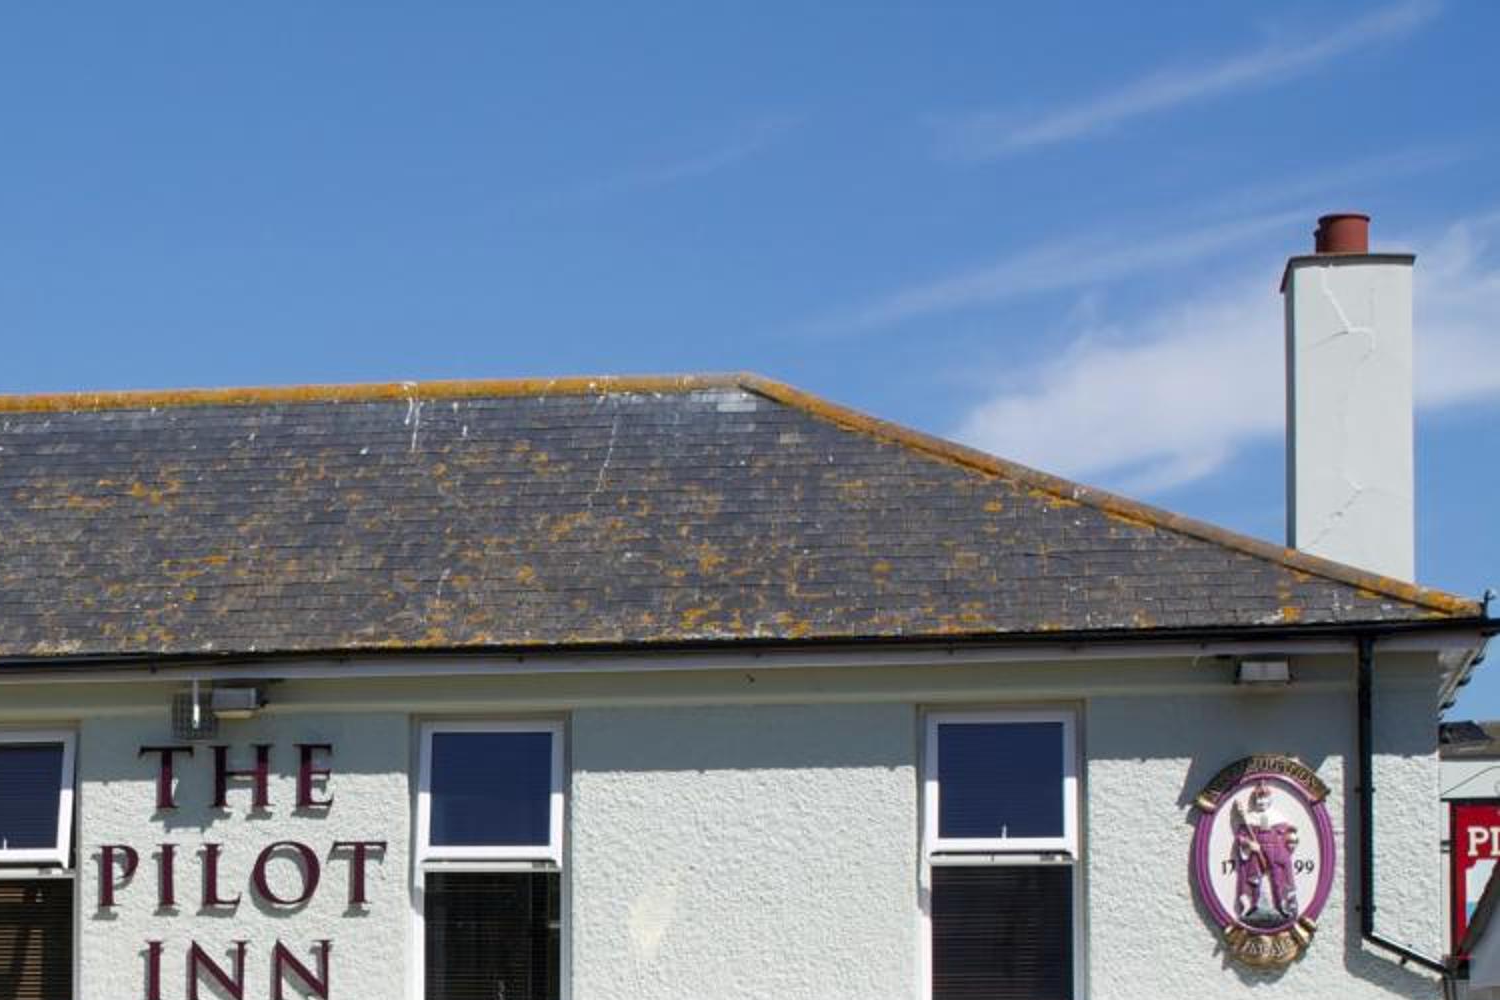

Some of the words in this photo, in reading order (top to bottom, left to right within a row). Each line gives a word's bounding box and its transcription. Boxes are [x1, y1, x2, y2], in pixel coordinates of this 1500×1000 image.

[138, 743, 334, 809] THE
[98, 841, 388, 907] PILOT
[1294, 859, 1315, 875] 99
